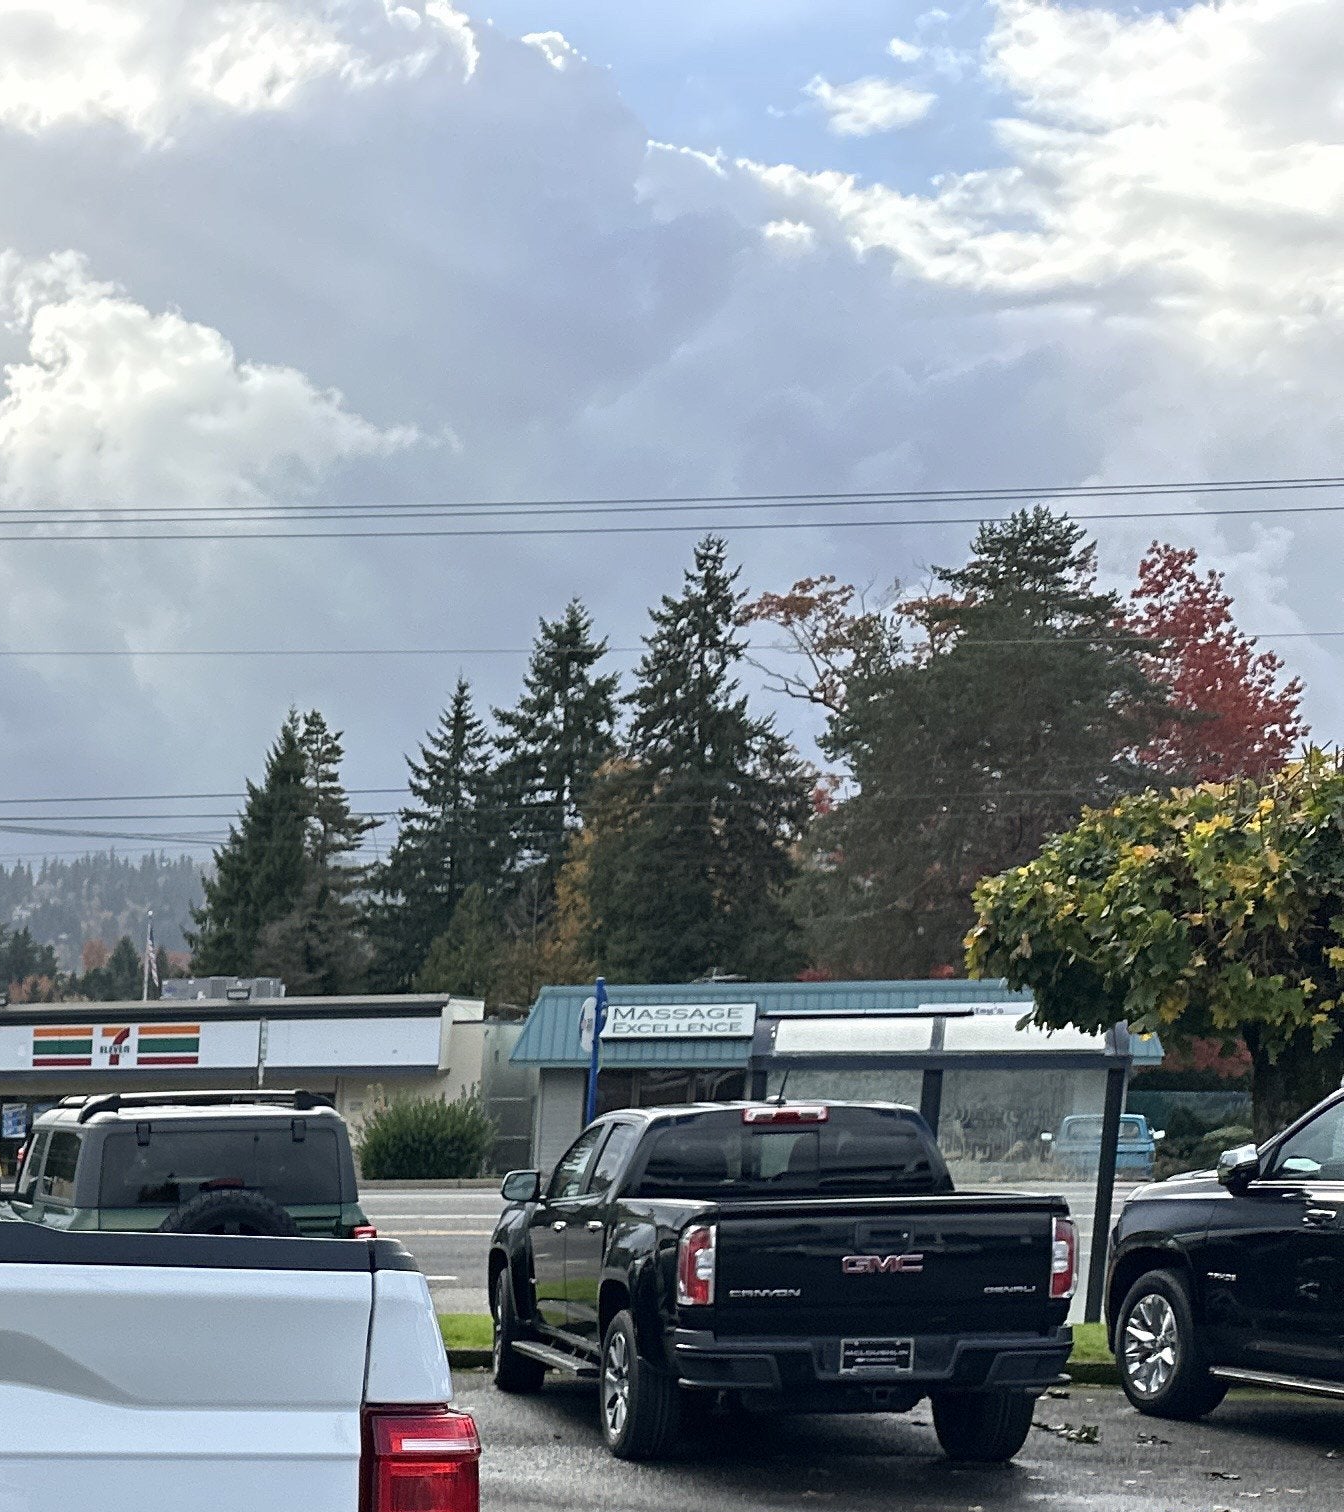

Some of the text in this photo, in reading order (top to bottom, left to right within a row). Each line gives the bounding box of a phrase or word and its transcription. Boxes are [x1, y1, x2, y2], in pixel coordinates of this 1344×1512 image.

[613, 1007, 744, 1020] MASSAGE
[612, 1022, 743, 1034] EXCELLENCE
[102, 1026, 130, 1066] 7
[842, 1254, 924, 1274] GMC
[729, 1285, 1036, 1298] CANYON DENALI
